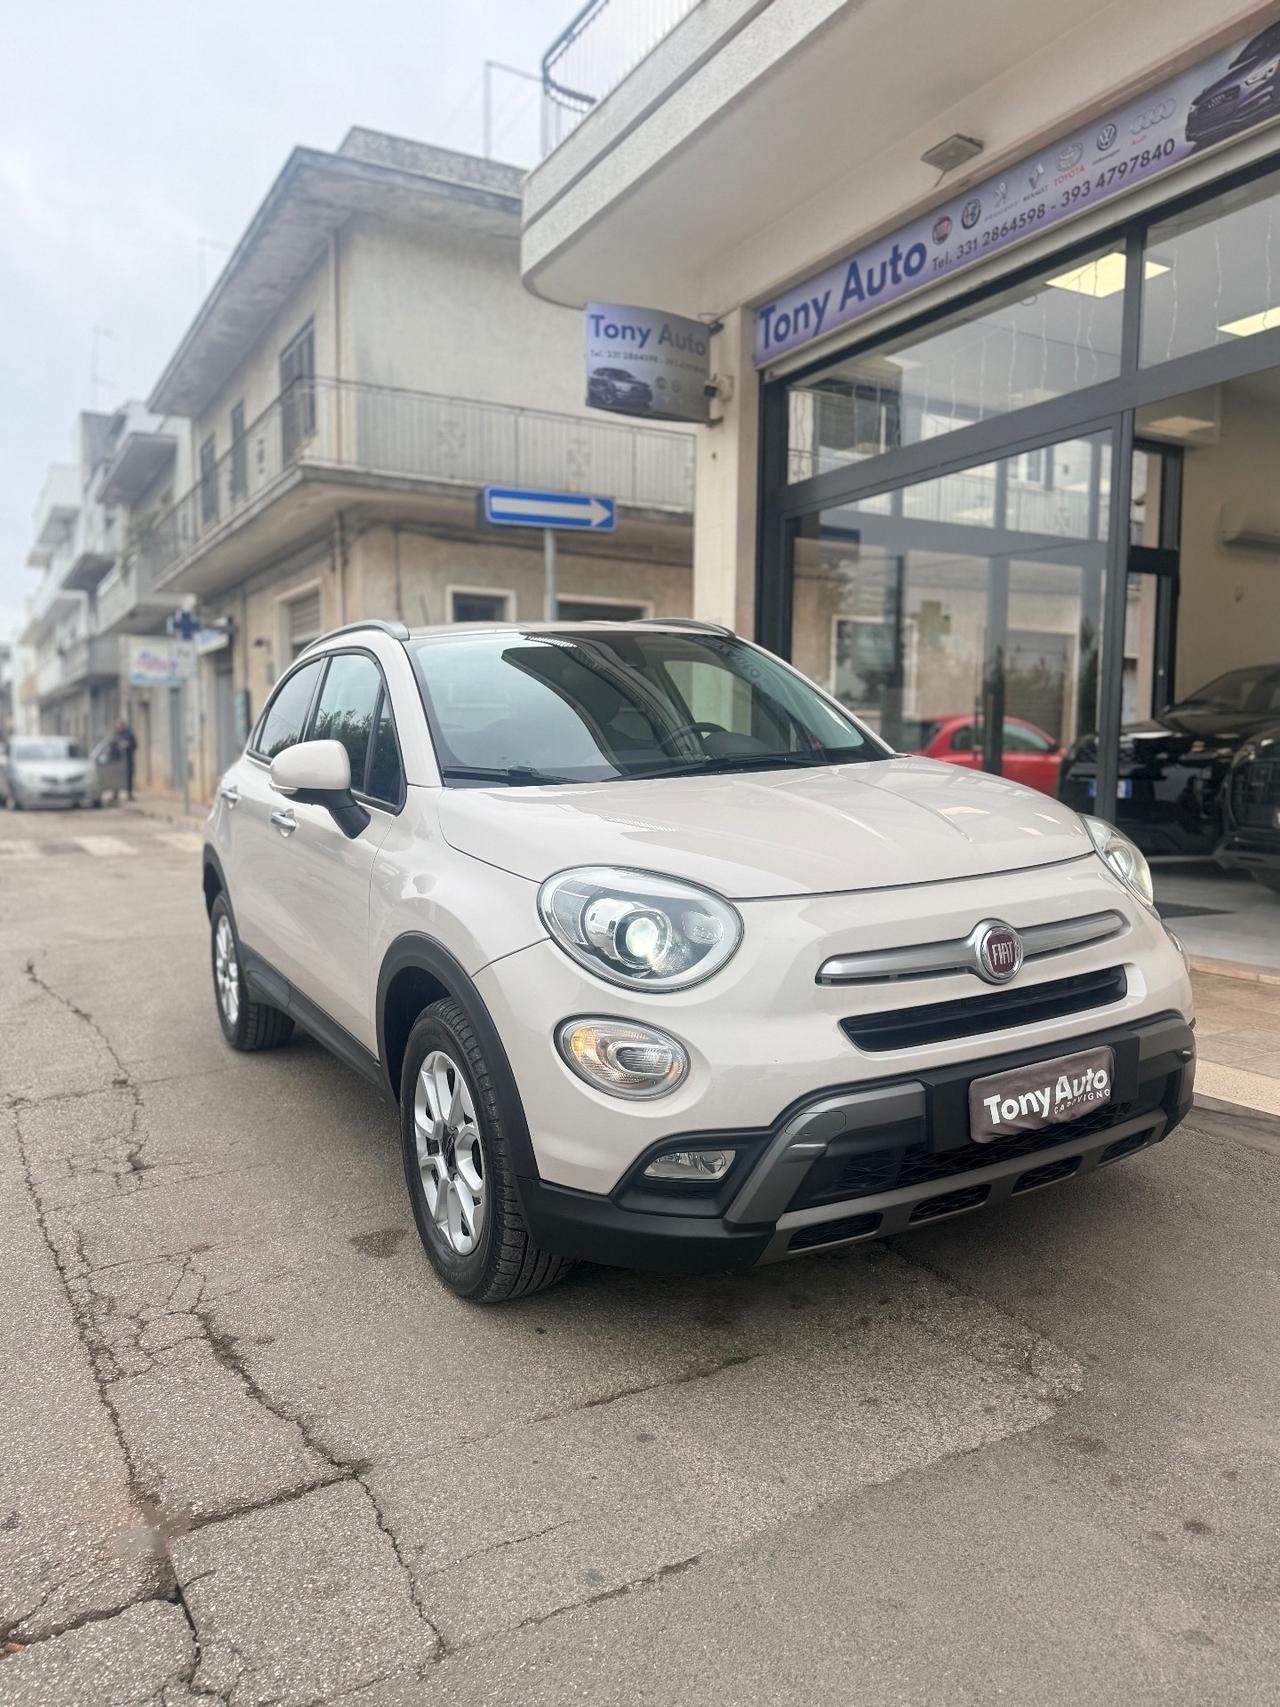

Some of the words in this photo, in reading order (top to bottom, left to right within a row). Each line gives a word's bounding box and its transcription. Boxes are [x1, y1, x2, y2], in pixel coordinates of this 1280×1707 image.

[1055, 164, 1086, 186] TOYOTA
[932, 251, 952, 271] Tel.
[957, 238, 978, 259] 331
[982, 203, 1046, 247] 2864598
[1061, 180, 1090, 208] 393
[1096, 138, 1175, 188] 4797840
[759, 289, 832, 350] Tony
[838, 242, 927, 312] Auto
[589, 314, 652, 349] Tony
[658, 323, 706, 356] Auto
[991, 941, 1013, 966] FIAT
[983, 1087, 1051, 1125] Tony
[1055, 1068, 1108, 1105] Auto
